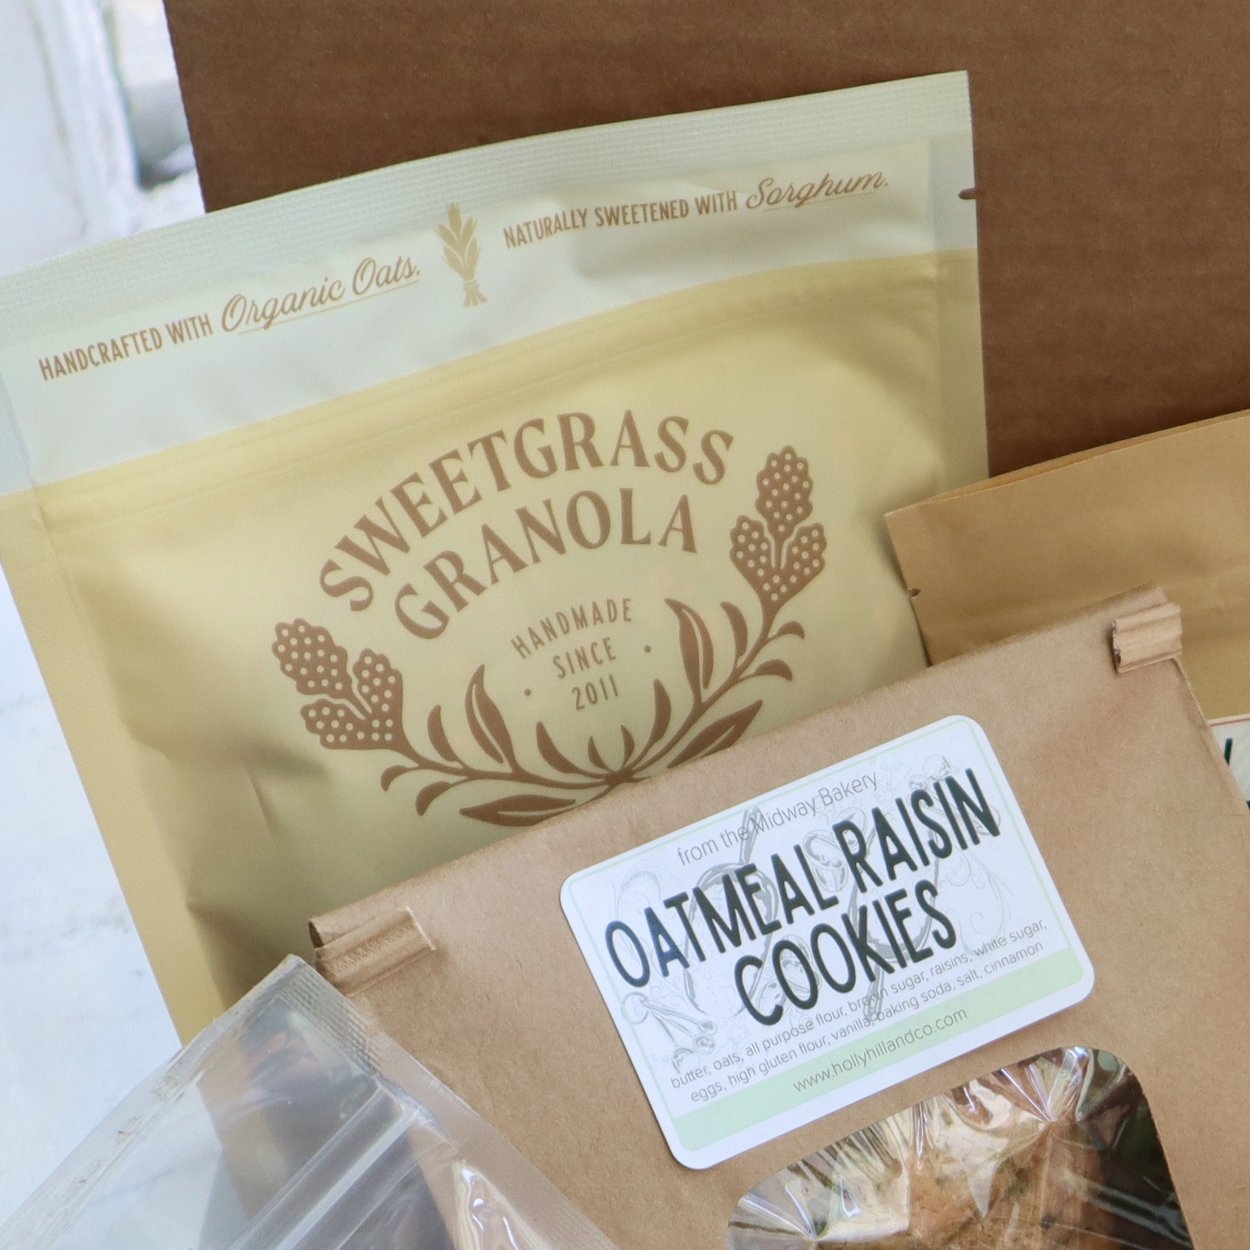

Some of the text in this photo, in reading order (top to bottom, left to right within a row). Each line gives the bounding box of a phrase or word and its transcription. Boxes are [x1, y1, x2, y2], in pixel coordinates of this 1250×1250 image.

[503, 171, 889, 249] NATURALLY SWEETENED WITH Sorghum.
[38, 256, 420, 382] HANDCRAFTED WITH Organic Oats.
[319, 409, 734, 612] SWEETGRASS
[394, 487, 698, 640] GRANOLA
[511, 598, 633, 659] HANDMADE
[552, 637, 617, 679] SINCE
[571, 674, 619, 711] 2011
[604, 768, 1001, 988] OATMEAL RAISIN
[677, 772, 879, 867] from the Midway Bakery
[670, 920, 1047, 1089] butter, oats, all purpose flour, brown sugar, raisins, white sugar,
[733, 879, 957, 1026] COOKIES
[690, 942, 1043, 1104] eggs, high gluten flour, vanilla, baking soda, salt, cinnamon
[793, 1007, 968, 1092] www.hollyhillandco.com
